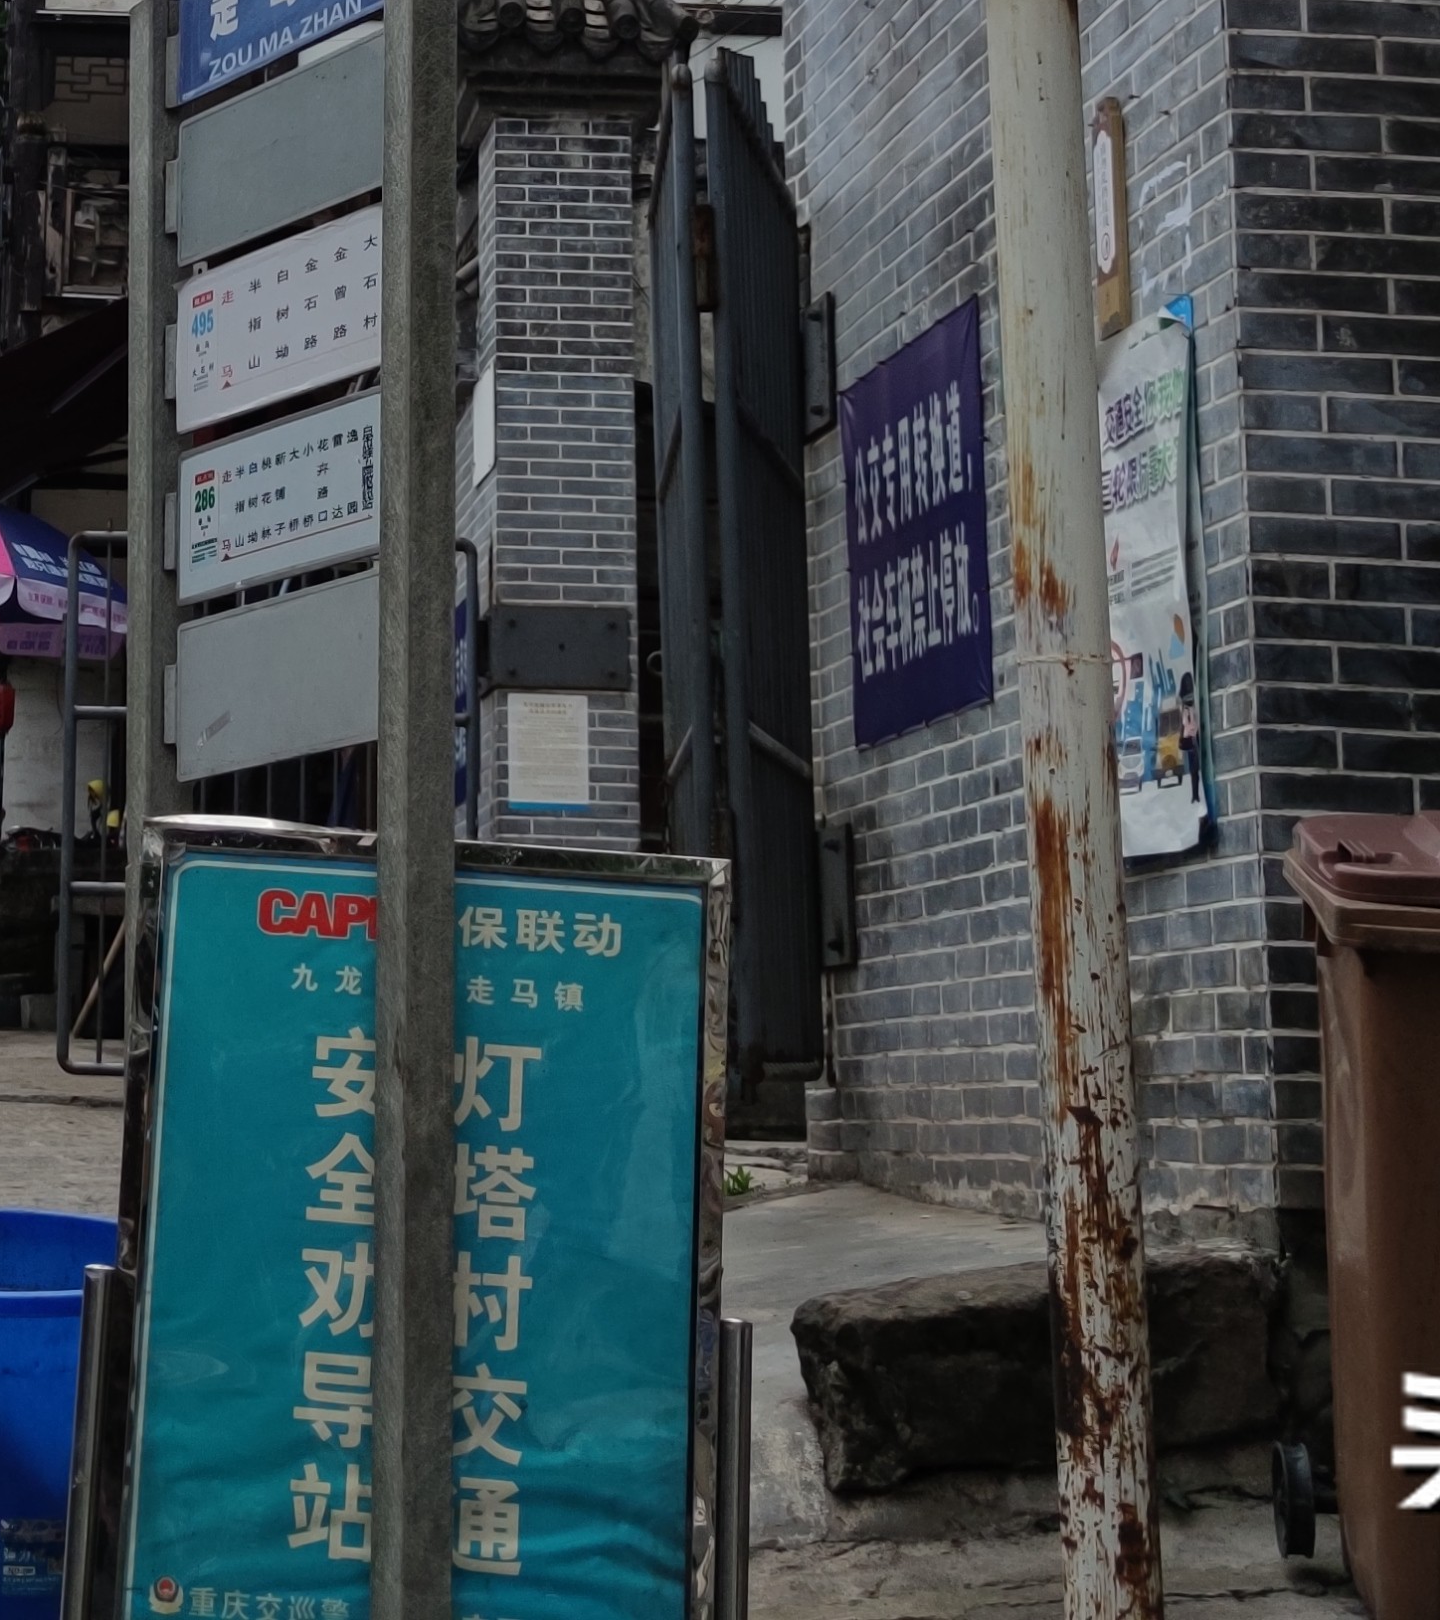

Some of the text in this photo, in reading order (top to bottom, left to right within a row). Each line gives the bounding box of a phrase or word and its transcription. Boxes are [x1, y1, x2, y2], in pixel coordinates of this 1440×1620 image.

[208, 42, 253, 82] ZOU
[258, 26, 295, 59] MA
[303, 257, 319, 351] 金石路
[363, 233, 379, 331] 大石村
[192, 308, 214, 339] 495
[194, 486, 216, 513] 286
[465, 975, 585, 1014] 走马镇
[287, 1026, 377, 1564] 安全劝导站
[452, 1035, 543, 1577] 灯塔村交通
